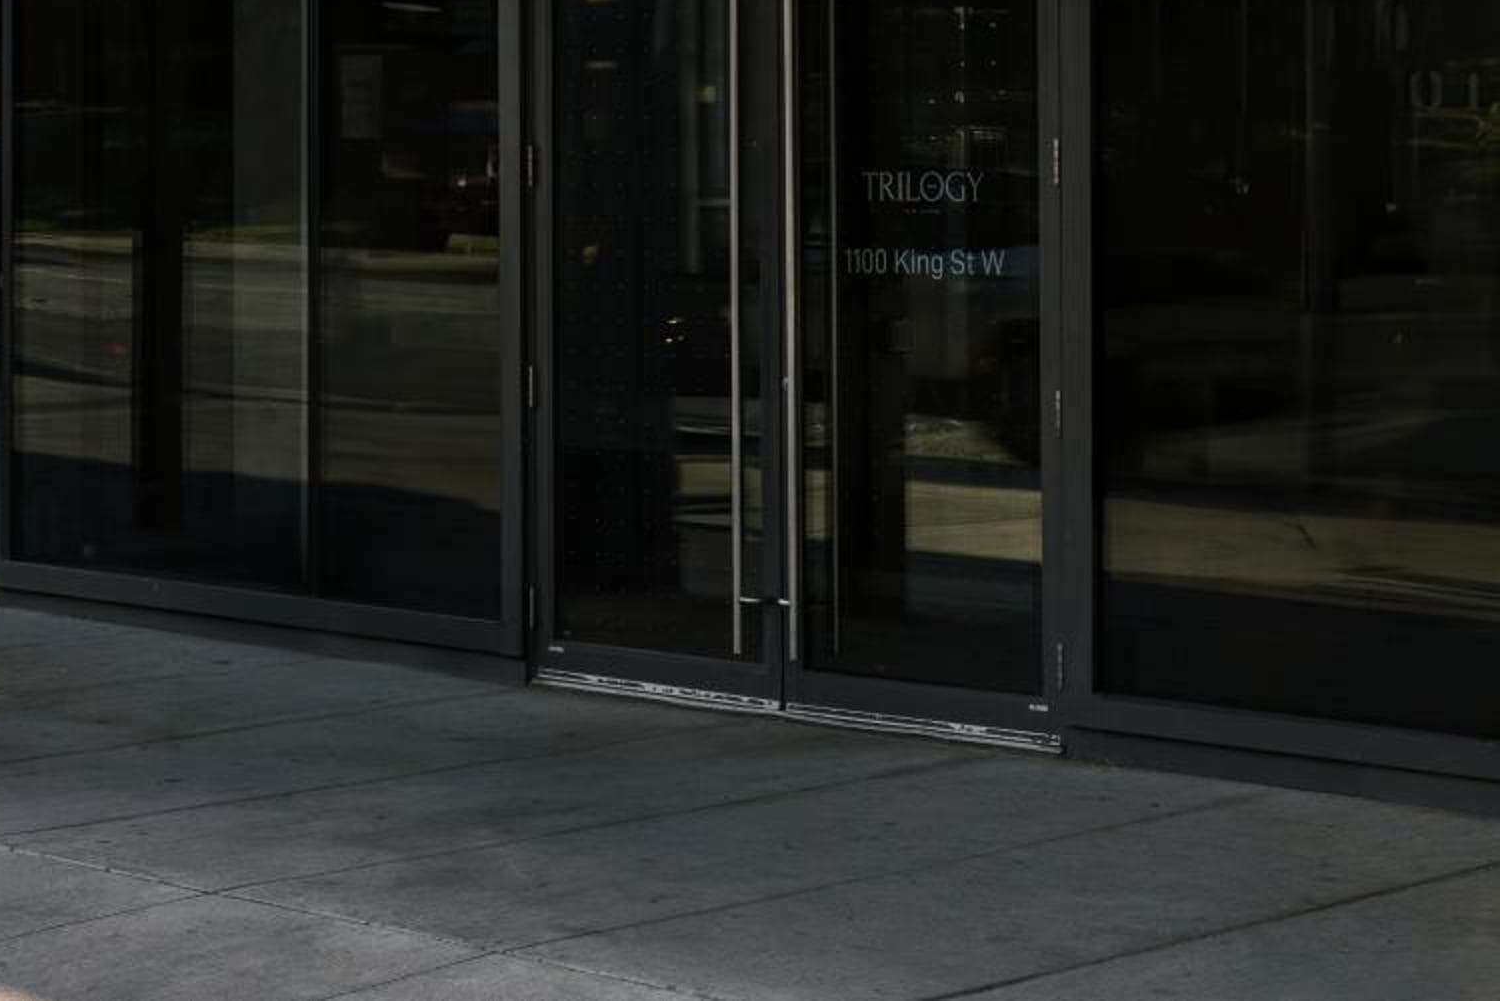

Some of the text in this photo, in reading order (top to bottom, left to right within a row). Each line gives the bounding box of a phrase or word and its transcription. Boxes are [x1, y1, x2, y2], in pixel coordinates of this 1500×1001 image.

[859, 170, 986, 202] TRILOGY
[844, 248, 1006, 280] 1100 King St W
